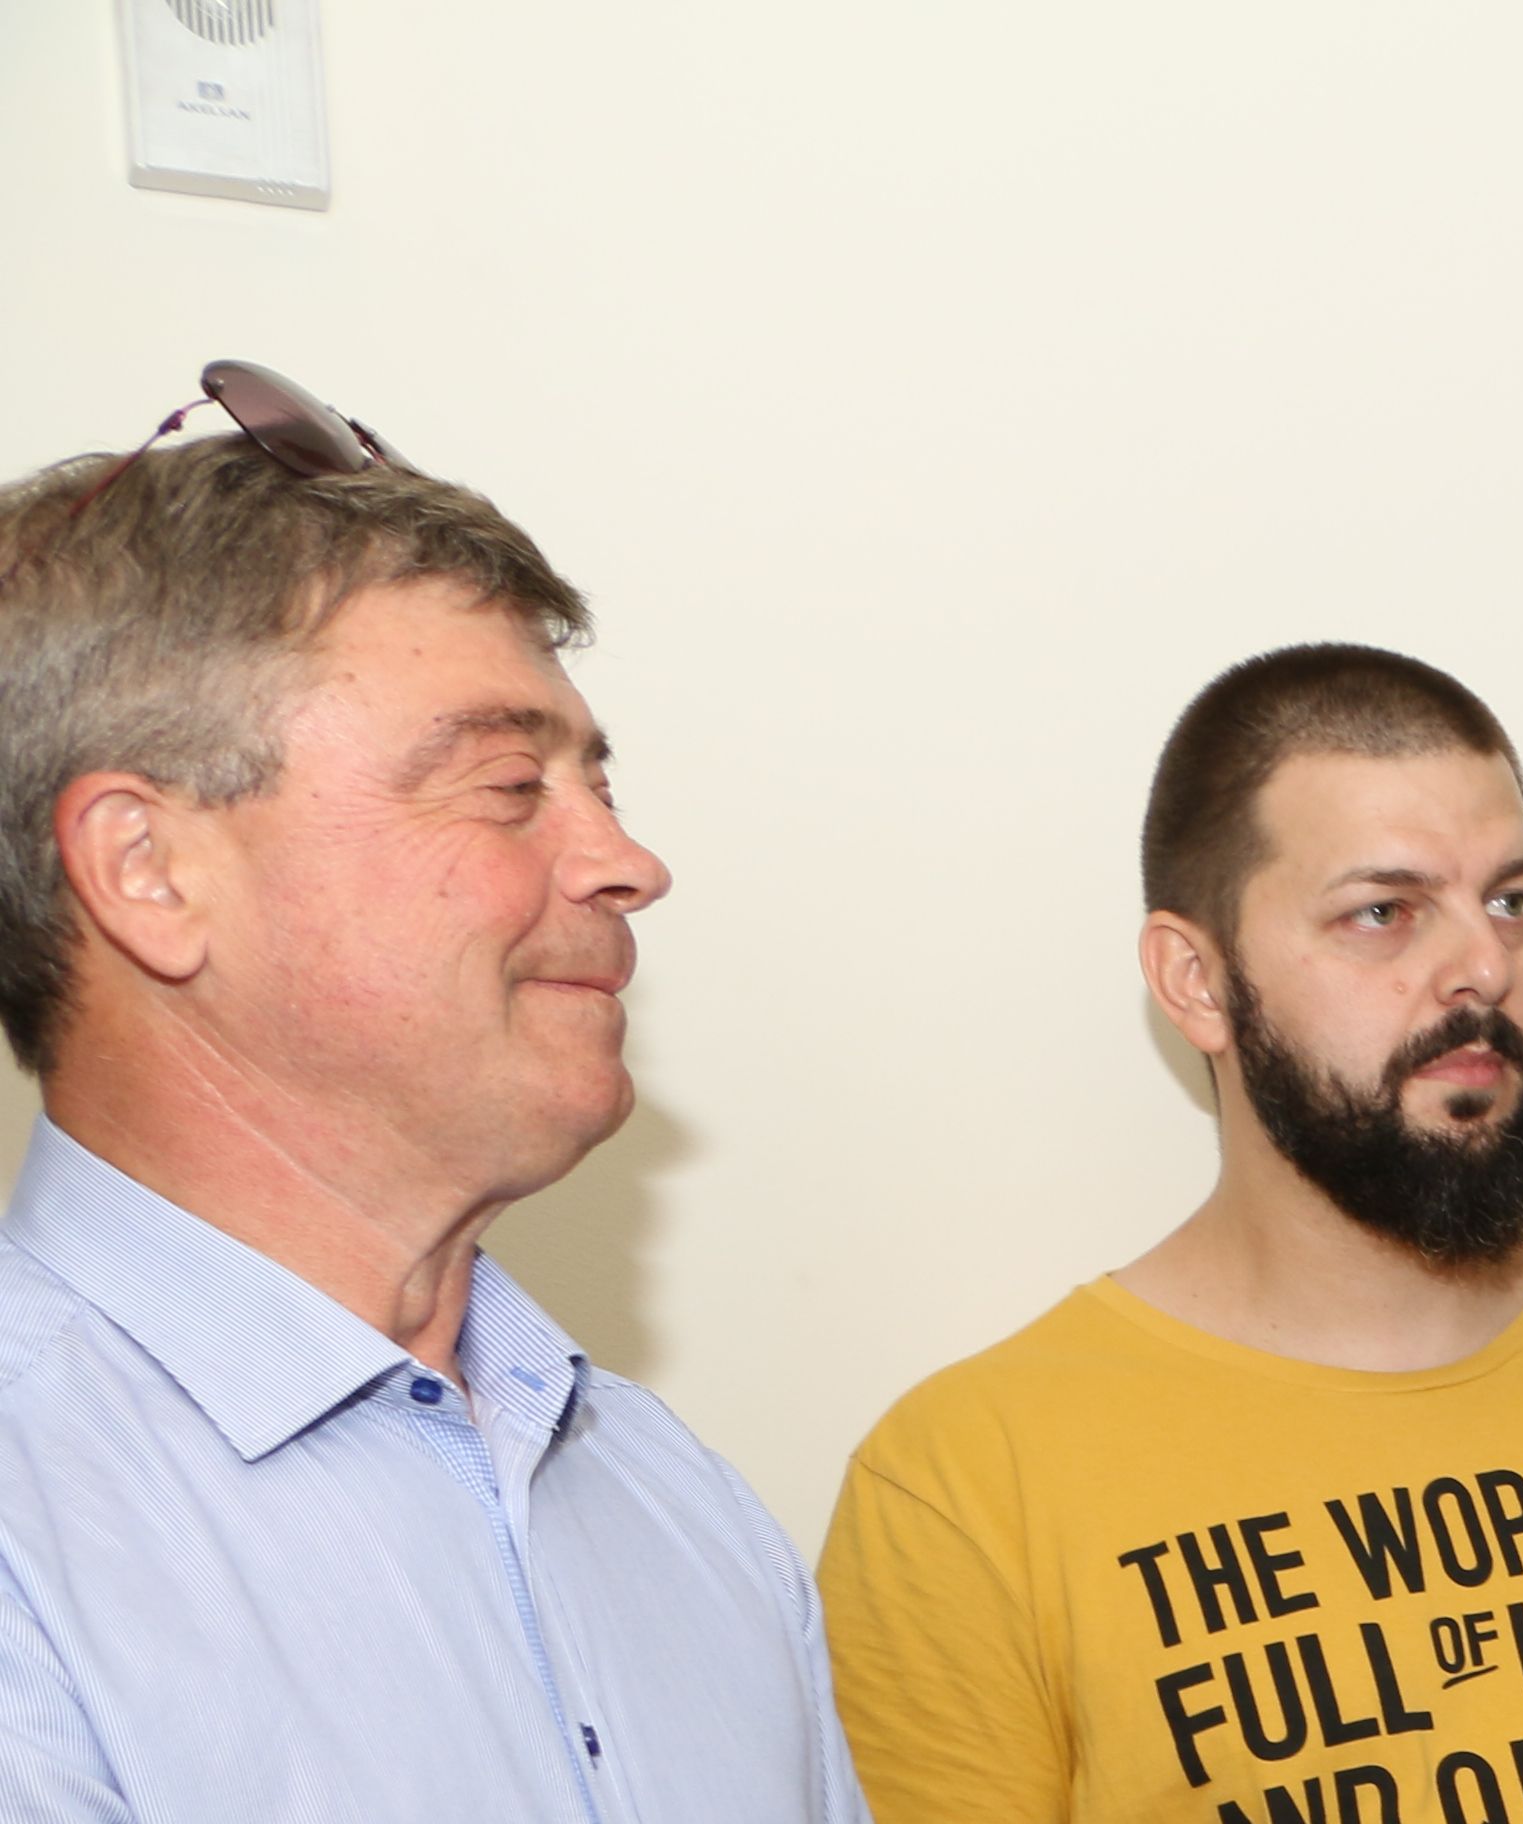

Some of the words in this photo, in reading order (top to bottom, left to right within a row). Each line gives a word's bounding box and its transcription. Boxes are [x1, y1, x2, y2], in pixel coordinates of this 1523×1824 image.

[1117, 1511, 1321, 1649] THE
[1154, 1621, 1435, 1789] FULL
[1428, 1610, 1499, 1676] OF
